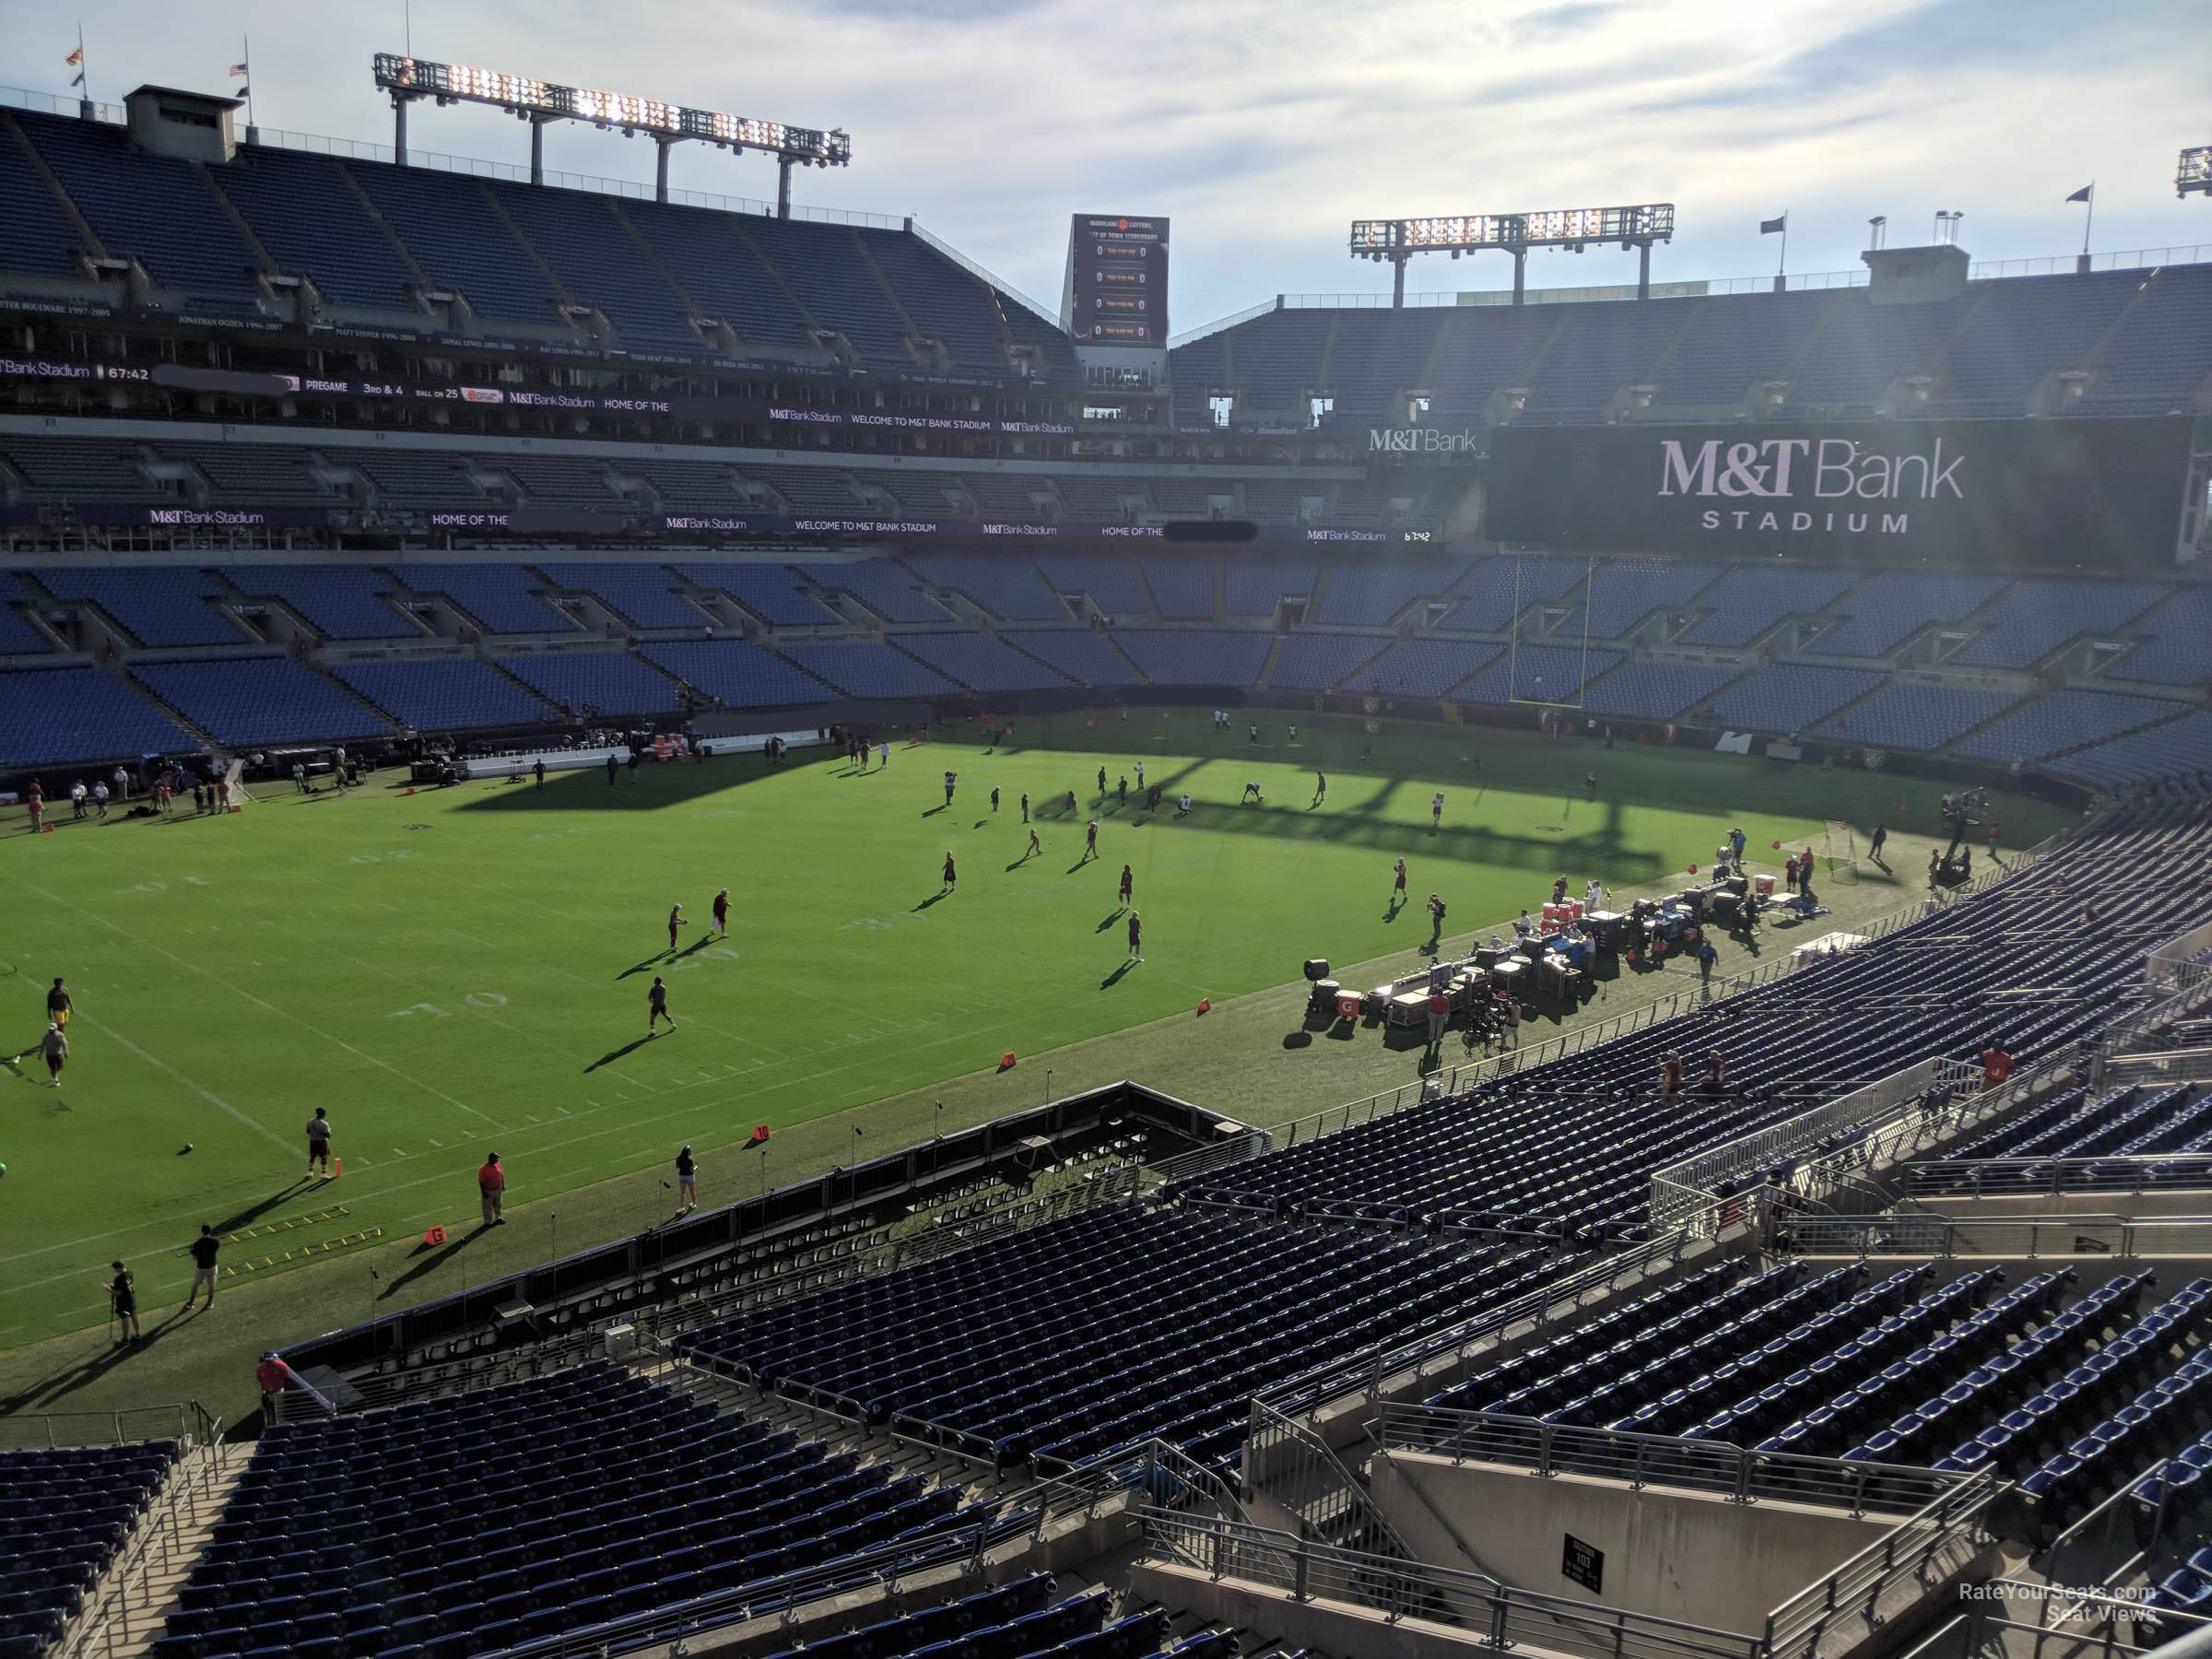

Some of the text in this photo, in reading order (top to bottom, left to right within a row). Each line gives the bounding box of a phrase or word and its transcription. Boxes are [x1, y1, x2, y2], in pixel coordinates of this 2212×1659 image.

[22, 302, 66, 314] BOULWARE
[179, 315, 218, 325] JONATHAN
[219, 319, 243, 328] OGDEN
[335, 328, 354, 337] MATT
[356, 330, 380, 339] STOVER
[442, 338, 463, 347] JAMAL
[464, 340, 483, 348] LEWIS
[6, 359, 38, 375] Bank
[38, 361, 90, 378] Stadium
[109, 368, 148, 380] 67:42
[306, 381, 348, 393] PREGAME
[363, 383, 404, 395] 3RD & 4
[416, 390, 431, 398] BALL
[445, 389, 459, 399] 25
[510, 392, 535, 405] M&T
[534, 395, 558, 406] Bank
[558, 395, 595, 409] Stadium
[605, 399, 670, 413] HOME OF THE
[769, 408, 841, 423] M&T Bank Stadium
[852, 415, 990, 430] WELCOME TO M&T BANK STADIUM
[1001, 421, 1075, 435] M&T Bank Stadium
[1369, 428, 1477, 452] M&T Bank
[1657, 437, 1966, 499] M&T Bank
[150, 510, 265, 524] M&T Bank Stadium
[432, 514, 509, 526] HOME OF THE
[666, 517, 747, 530] M&T Bank Stadium
[1701, 511, 1909, 535] STADIUM
[795, 521, 936, 533] WELCOME TO M&T BANK STADIUM
[982, 524, 1058, 536] M&T Bank Stadium
[1101, 527, 1165, 537] HOME OF THE
[1307, 530, 1387, 543] M&T Bank Stadium
[1404, 532, 1430, 542] 67:42
[1341, 1000, 1354, 1013] G
[757, 1126, 768, 1140] 10
[432, 1228, 443, 1243] G
[1576, 1552, 1592, 1570] 103
